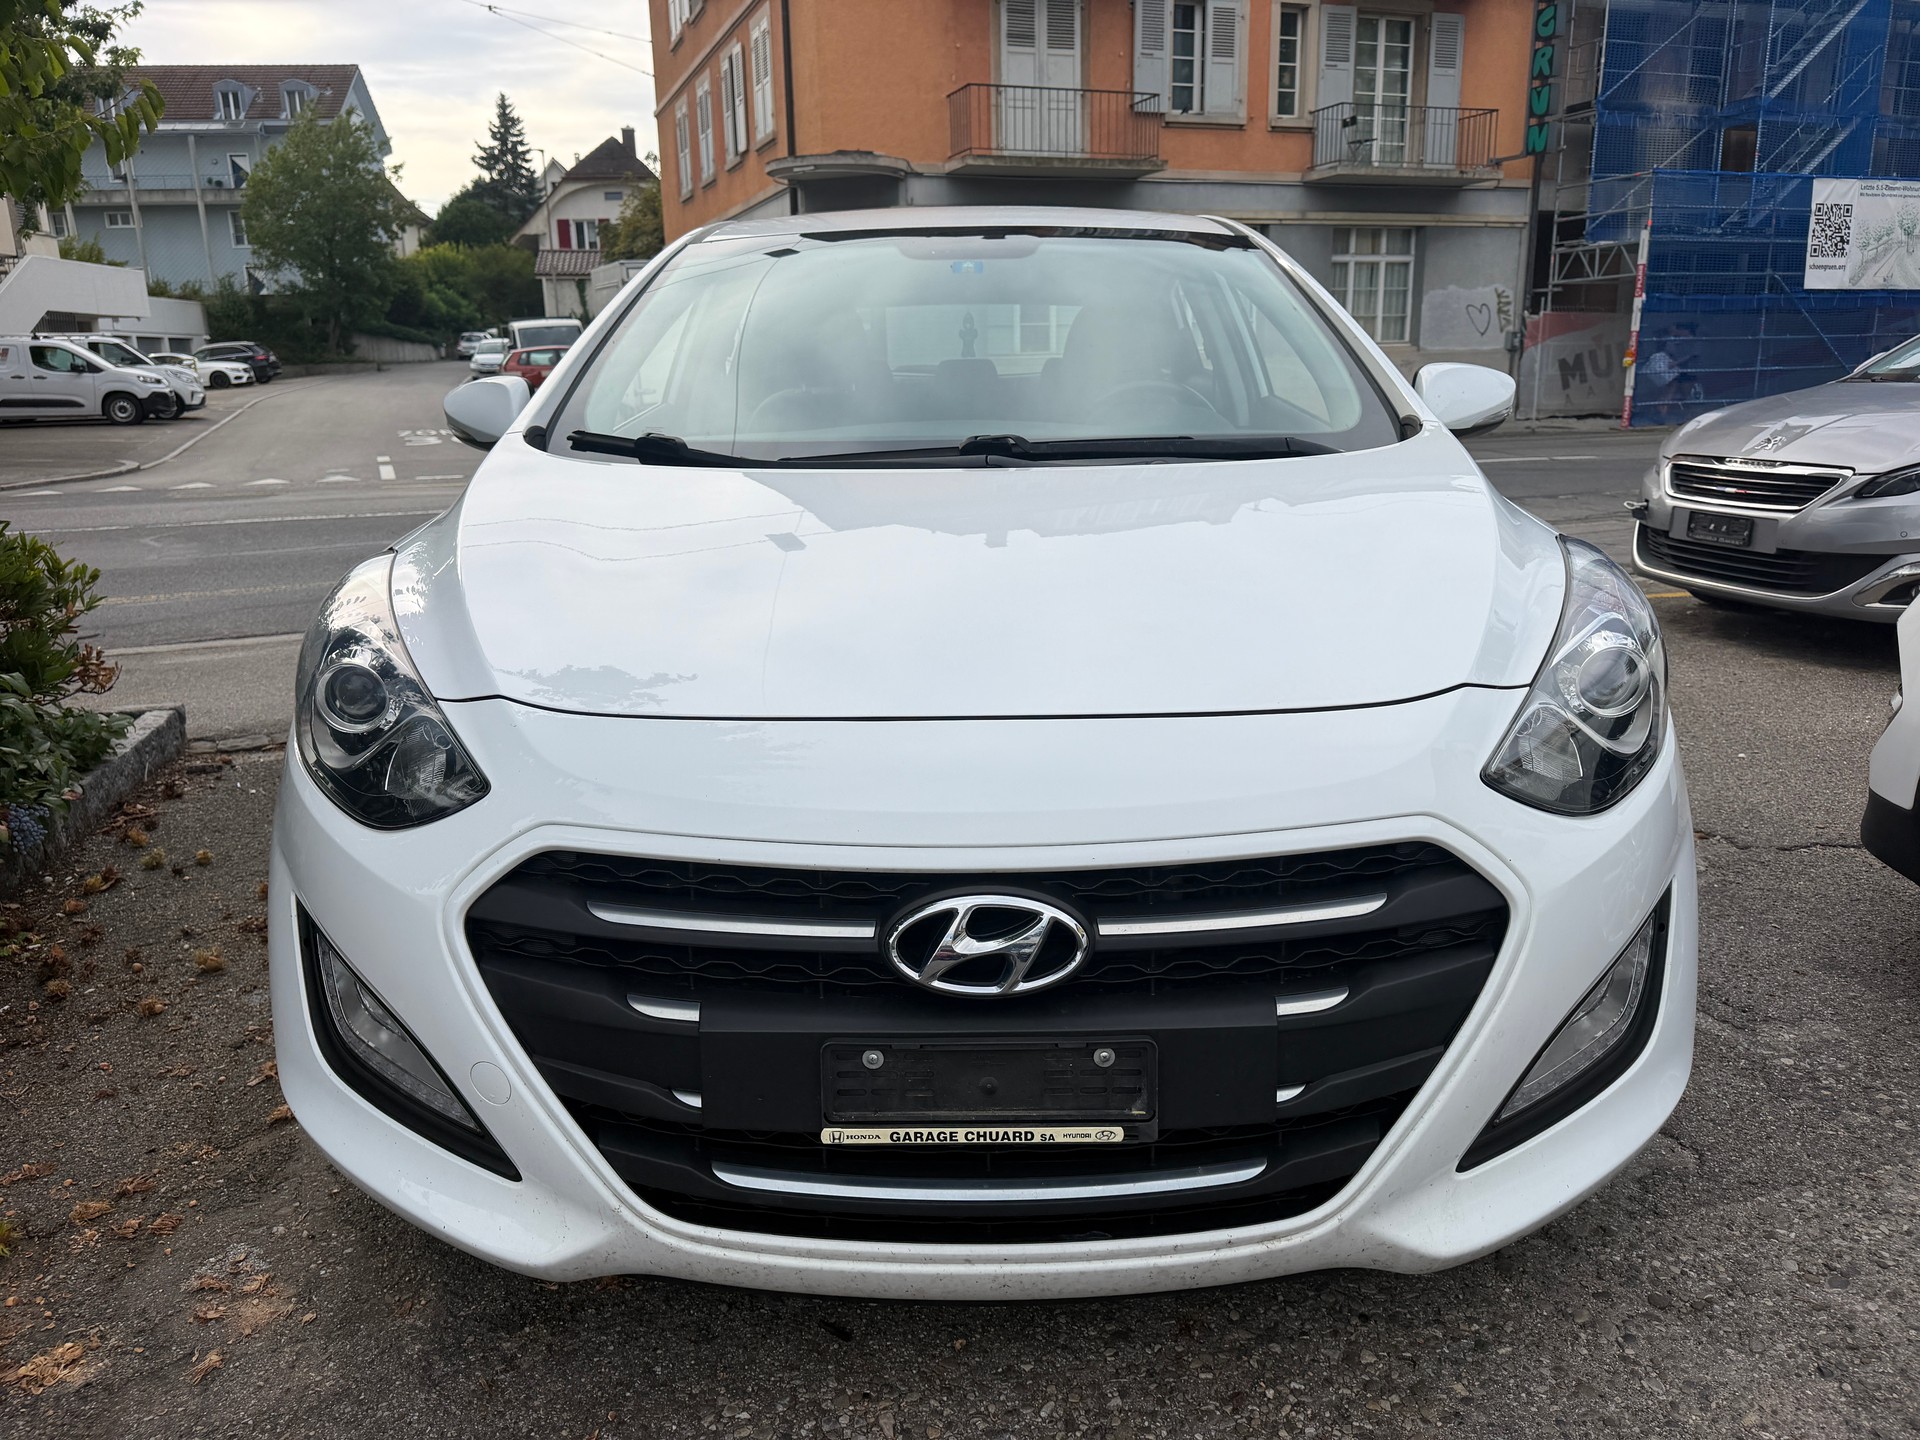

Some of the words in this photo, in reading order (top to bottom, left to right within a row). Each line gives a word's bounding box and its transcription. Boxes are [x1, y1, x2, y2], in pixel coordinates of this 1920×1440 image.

[889, 1131, 959, 1143] GARAGE
[964, 1130, 1035, 1142] CHUARD
[1040, 1133, 1056, 1142] SA
